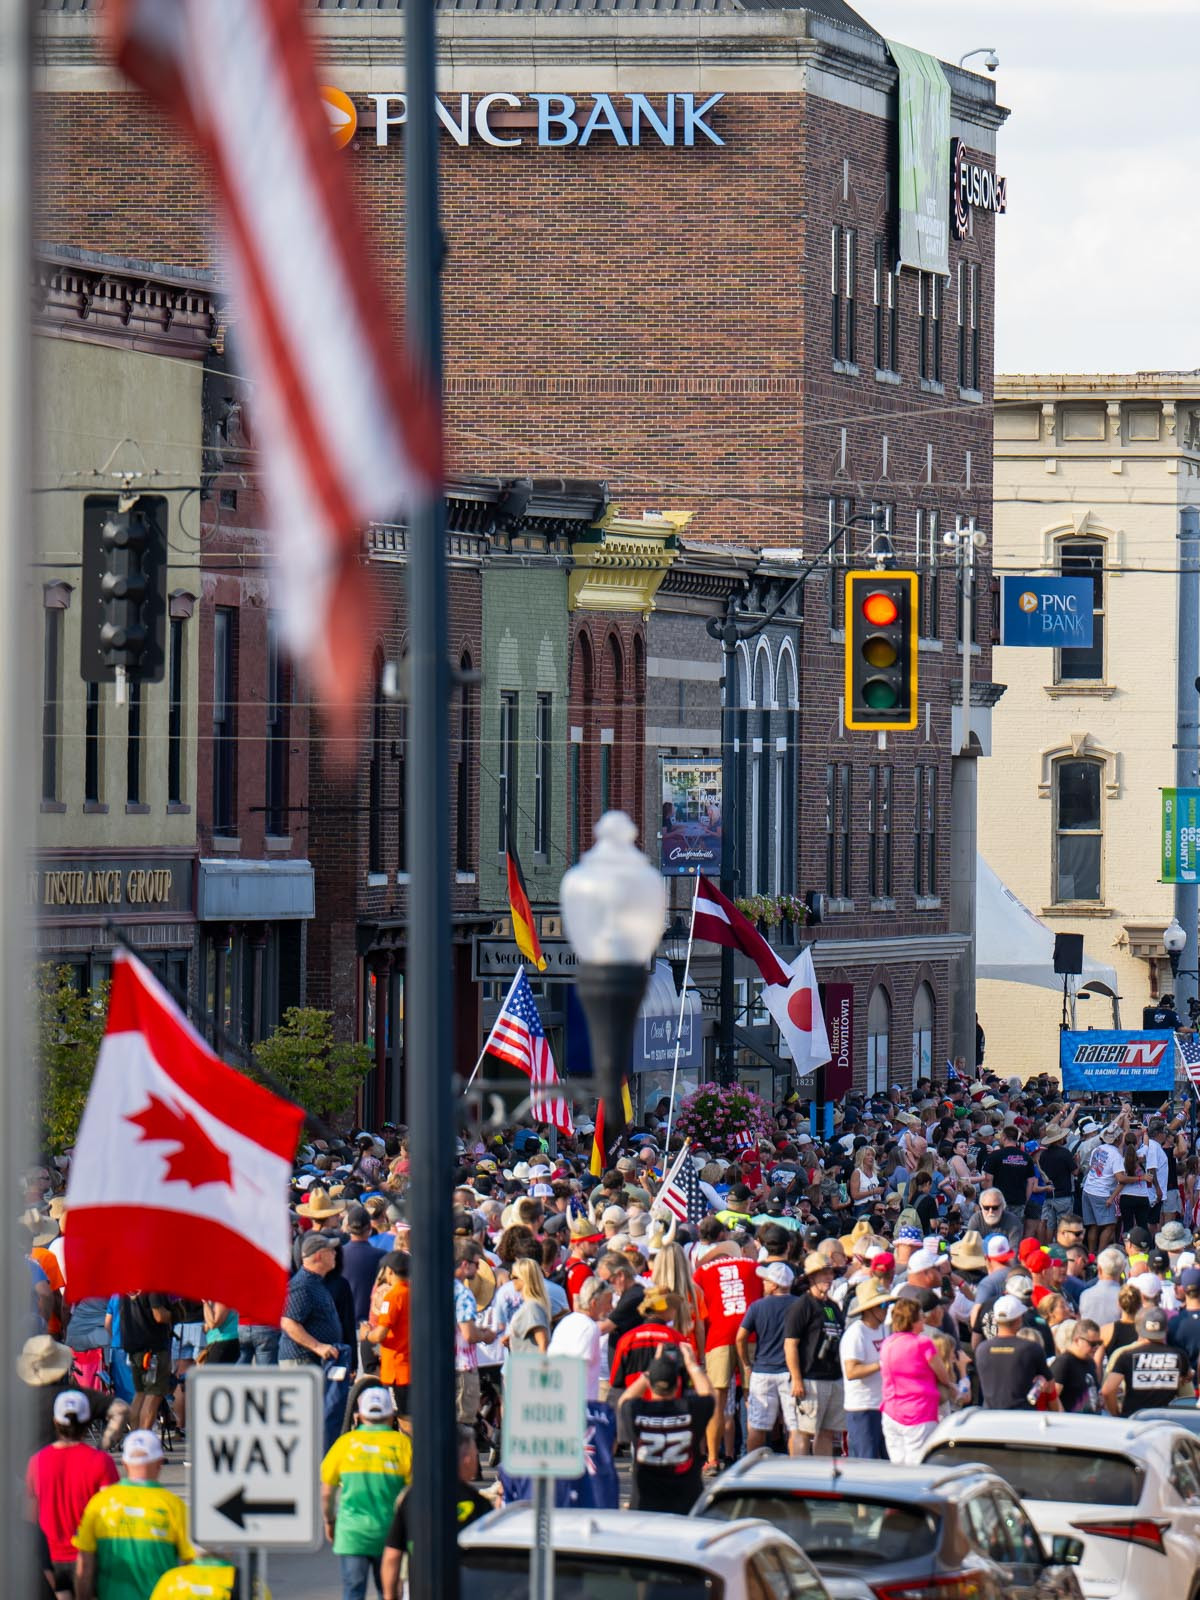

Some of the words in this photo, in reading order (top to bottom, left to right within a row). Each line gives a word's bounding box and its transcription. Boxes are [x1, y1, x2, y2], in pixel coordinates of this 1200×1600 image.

[367, 93, 523, 147] PNC
[528, 93, 727, 147] BANK
[1041, 594, 1077, 611] PNC
[1041, 614, 1084, 631] BANK
[1180, 827, 1189, 870] COUNTY
[44, 871, 122, 906] INSURANCE
[127, 869, 173, 904] GROUP
[831, 1016, 840, 1055] Historic
[837, 999, 850, 1068] Downtown
[795, 1078, 814, 1087] 1823
[1136, 1353, 1179, 1369] HGS
[209, 1387, 299, 1425] ONE
[634, 1413, 692, 1427] REED
[209, 1435, 299, 1473] WAY
[637, 1430, 694, 1466] 22
